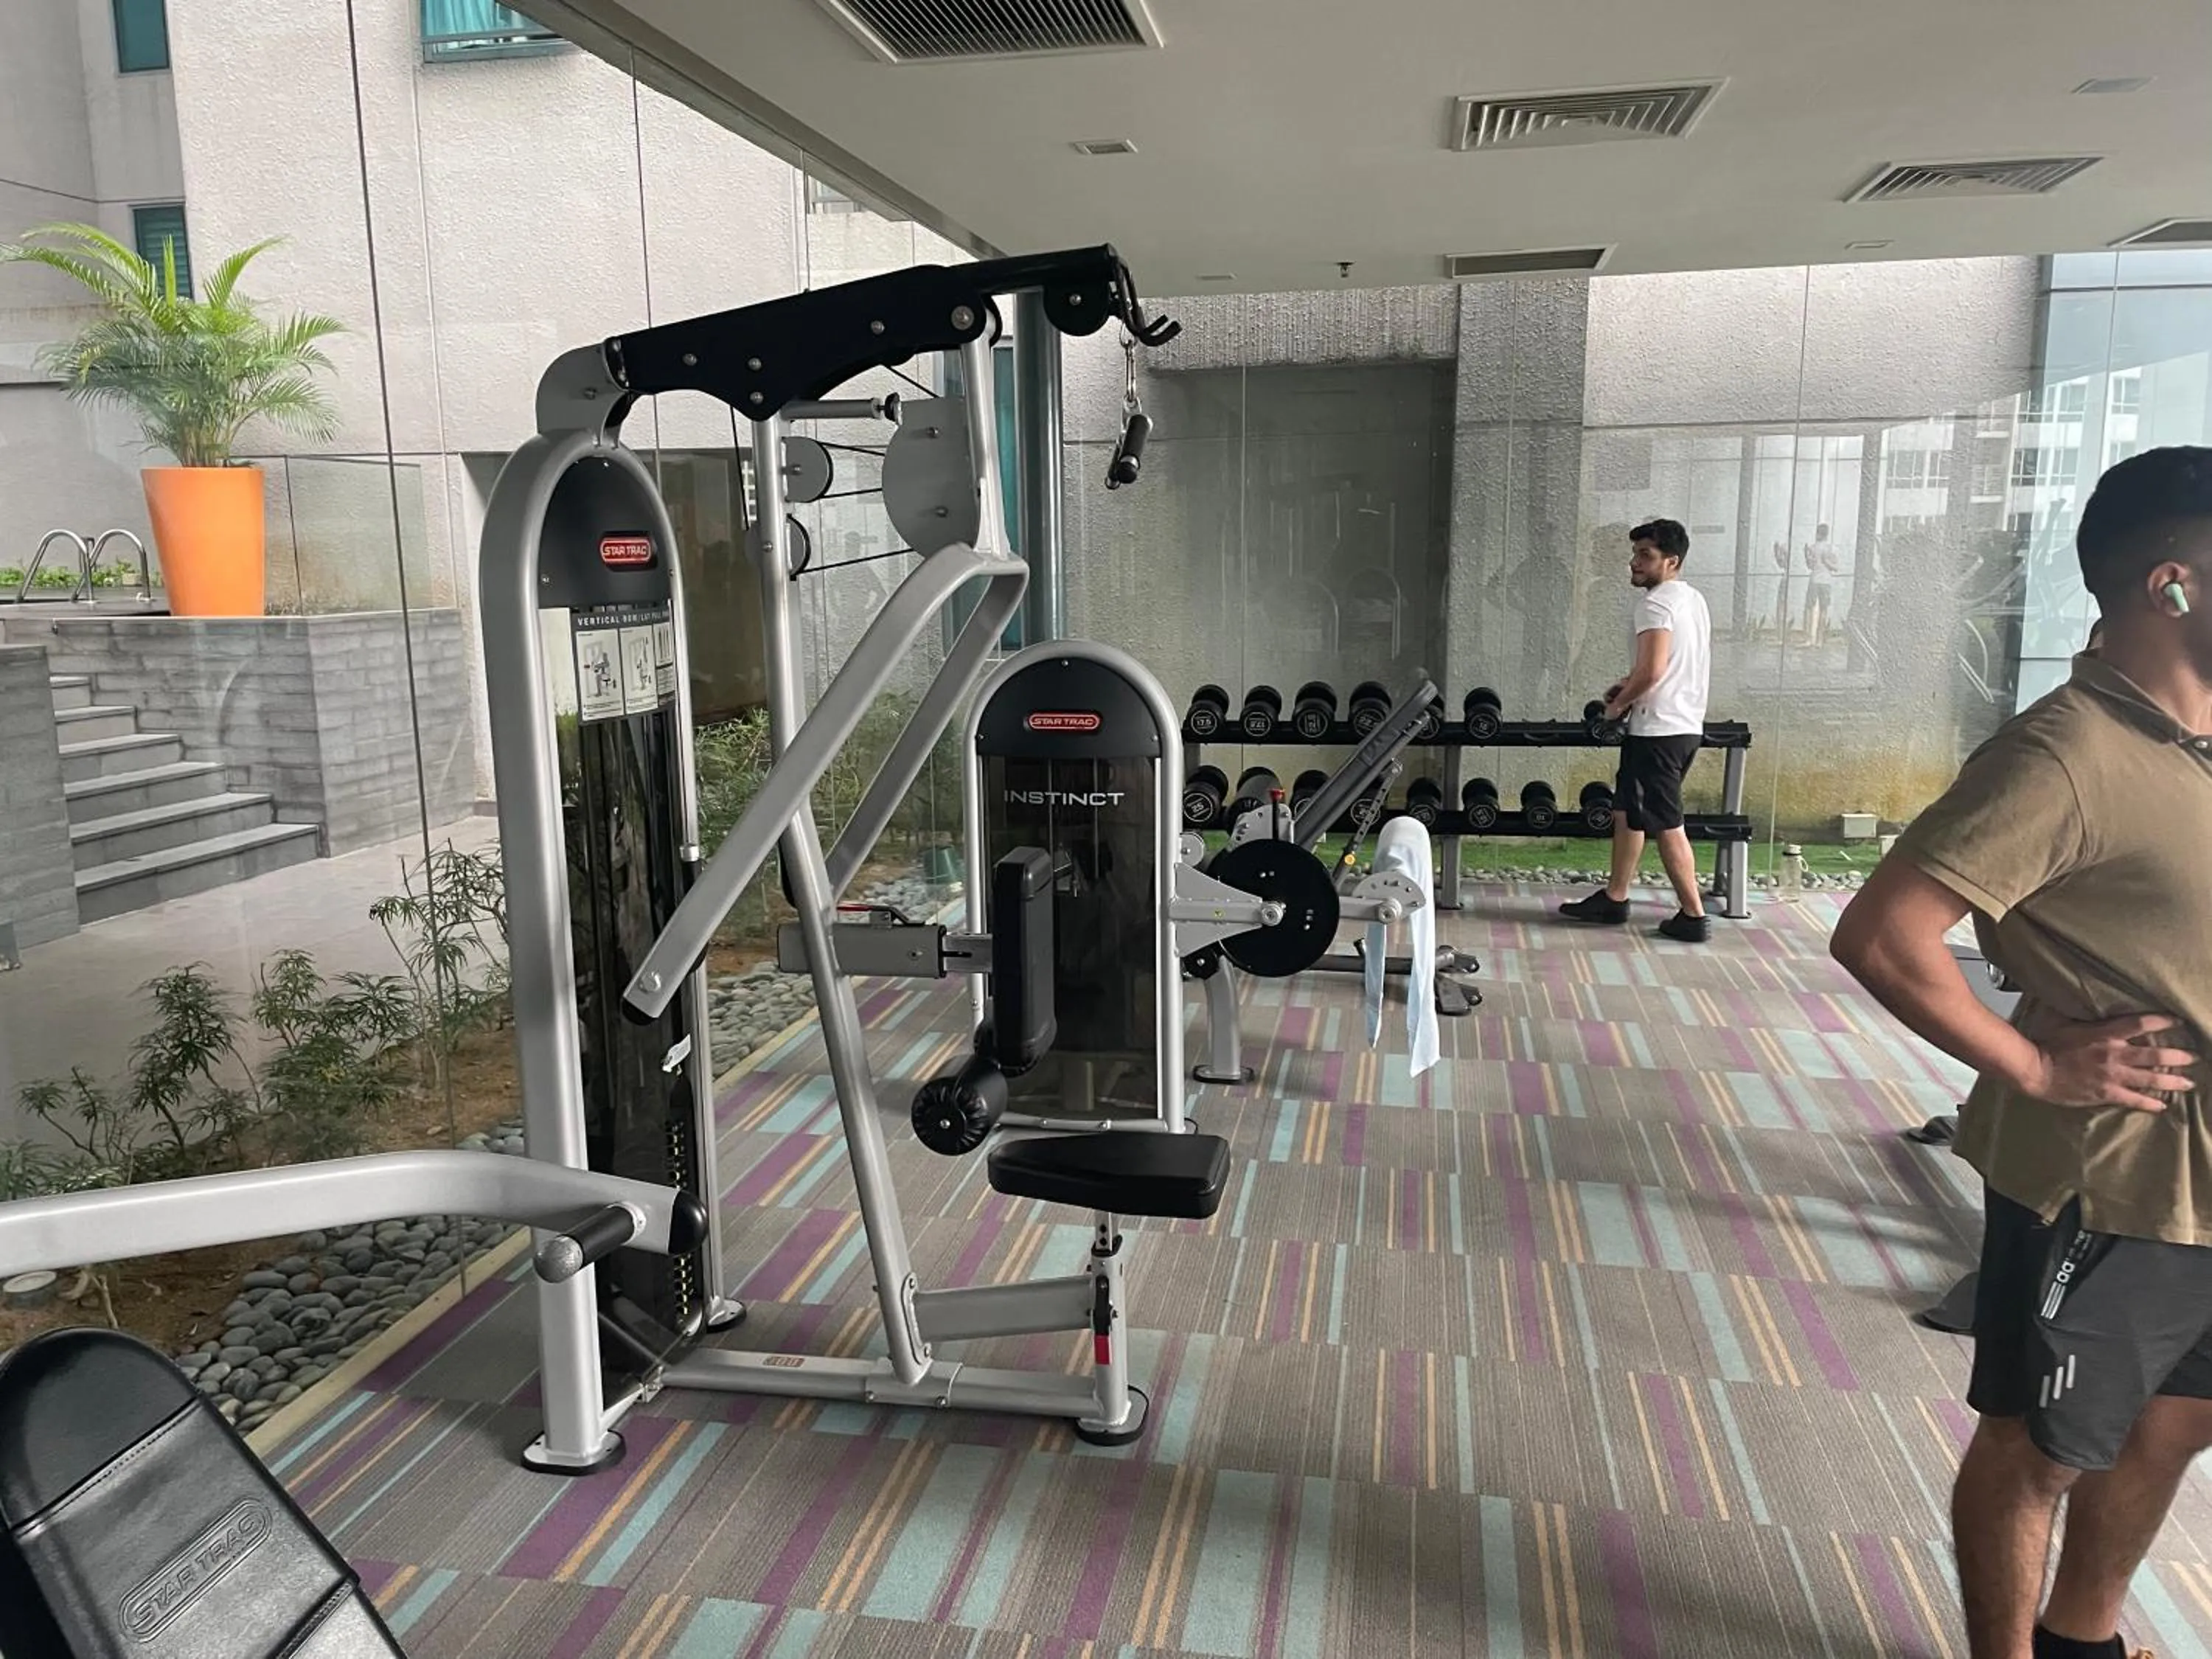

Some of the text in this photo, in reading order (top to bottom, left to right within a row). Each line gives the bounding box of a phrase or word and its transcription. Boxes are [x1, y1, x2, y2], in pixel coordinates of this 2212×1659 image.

[602, 546, 647, 555] STAR TRAC
[578, 616, 619, 625] VERTICAL
[1033, 717, 1093, 726] STAR TRAC
[1004, 790, 1125, 806] INSTINCT
[133, 1512, 257, 1631] STAR TRAC
